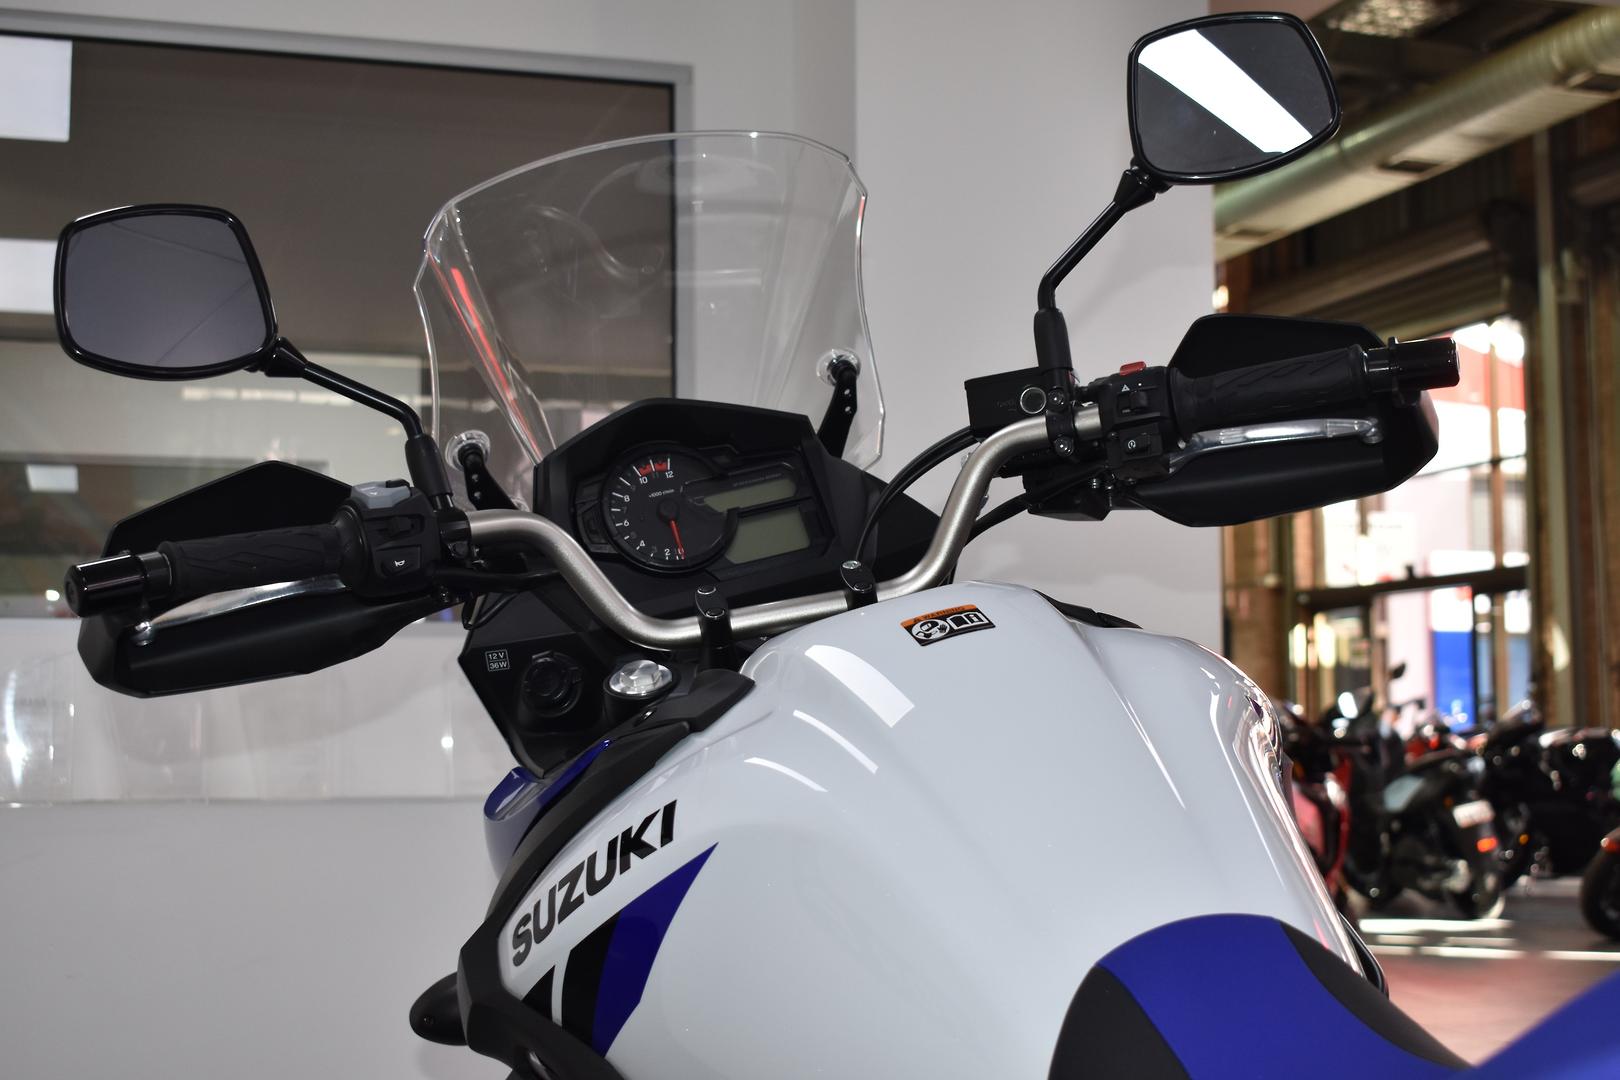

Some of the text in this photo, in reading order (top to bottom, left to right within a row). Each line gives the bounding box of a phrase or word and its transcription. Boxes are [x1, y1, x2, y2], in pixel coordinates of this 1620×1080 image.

[639, 476, 648, 484] 10
[664, 548, 671, 556] 2
[512, 799, 677, 967] SUZUKI
